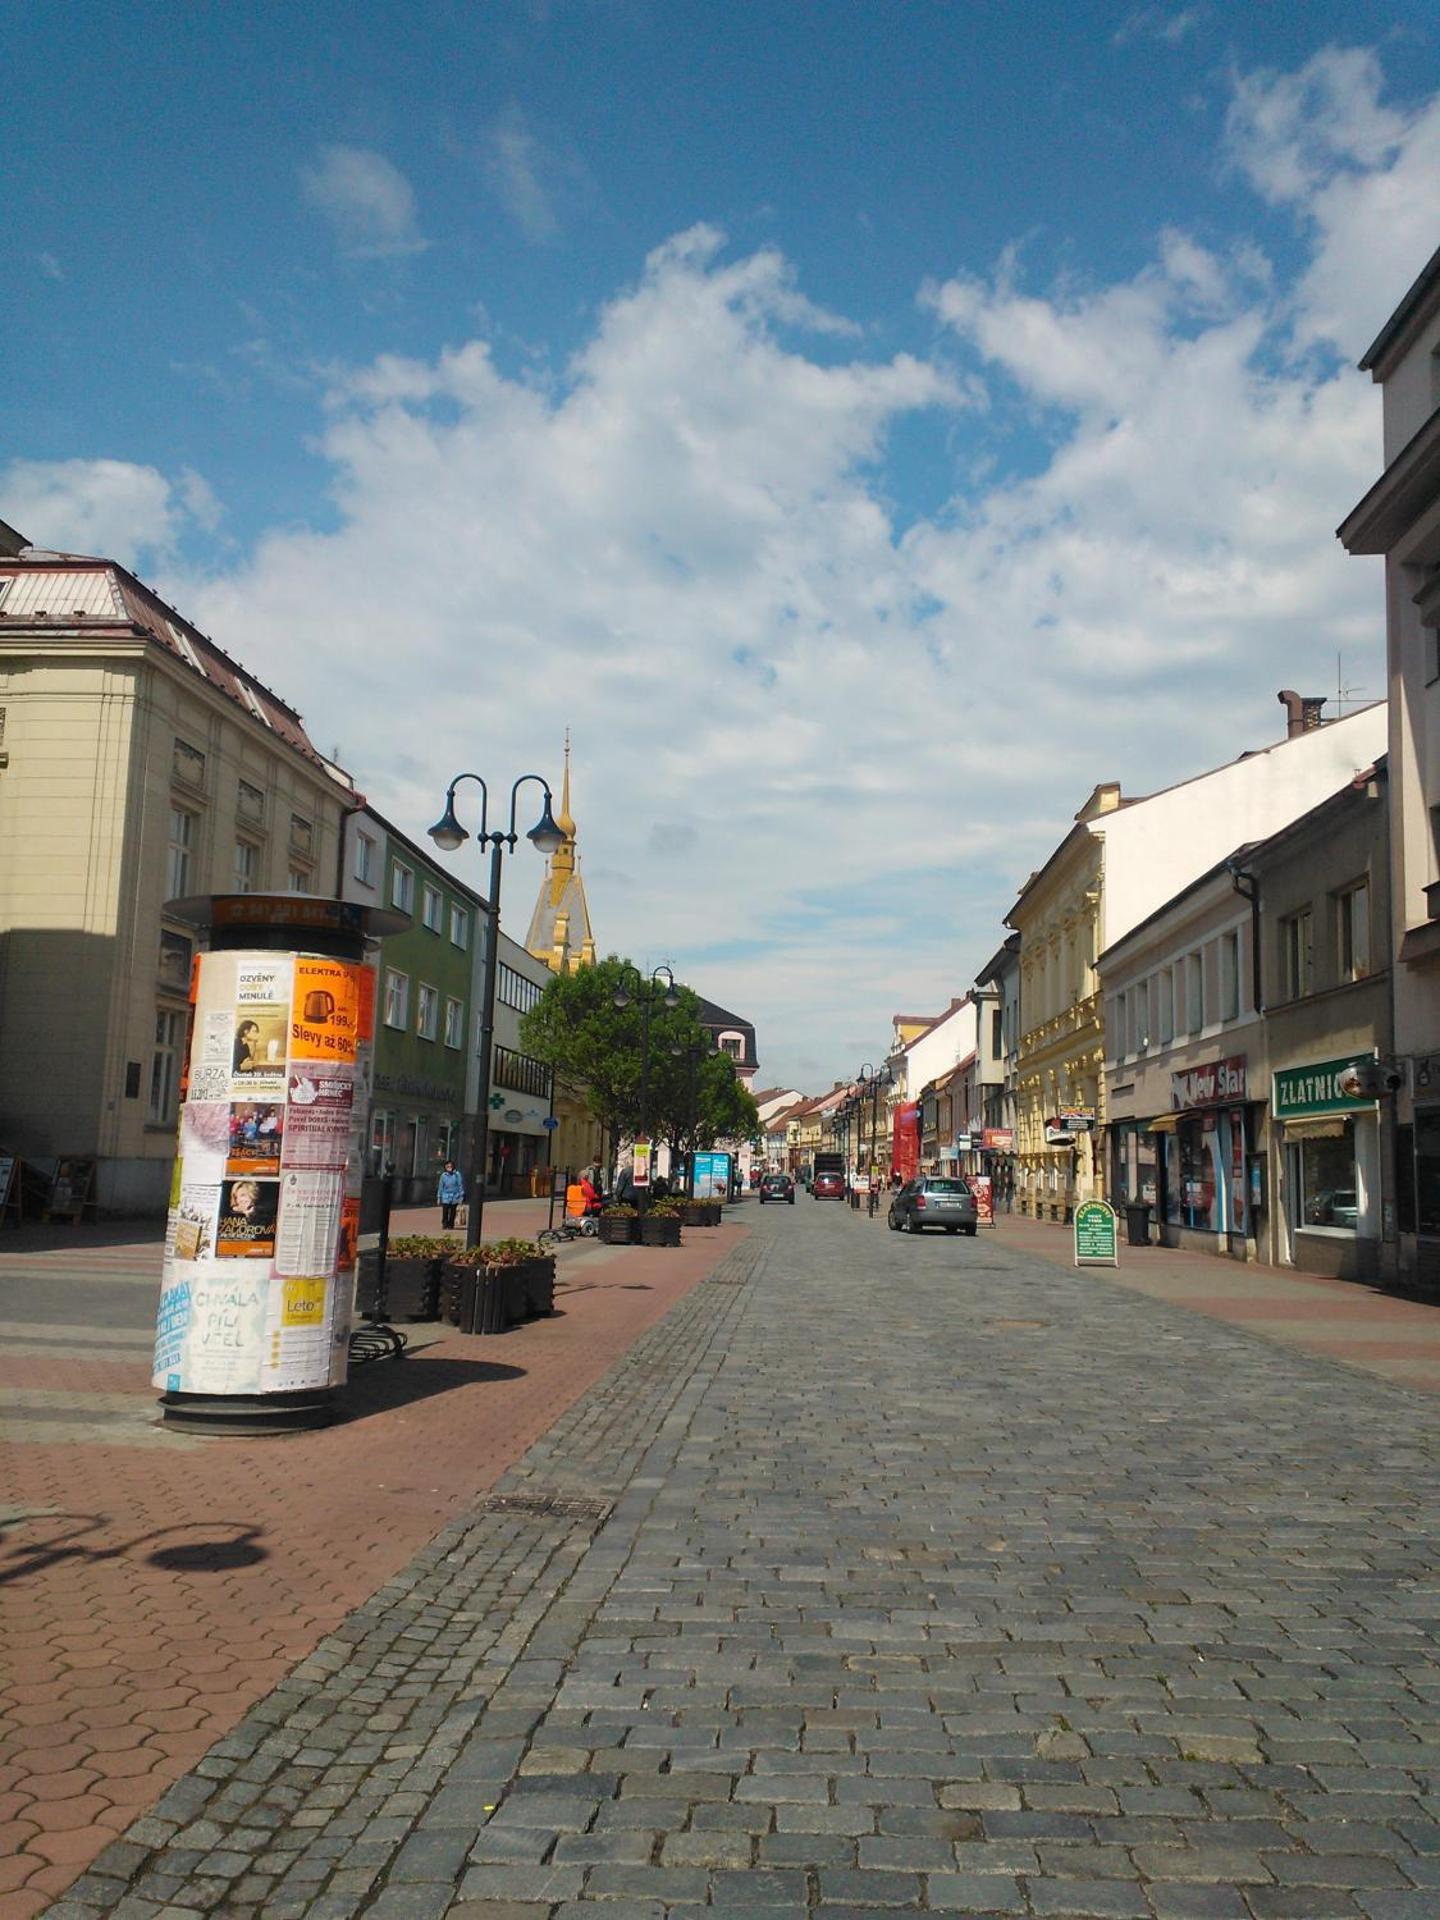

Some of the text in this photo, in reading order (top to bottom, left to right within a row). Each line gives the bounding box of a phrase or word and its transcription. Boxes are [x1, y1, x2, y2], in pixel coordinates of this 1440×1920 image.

[299, 966, 341, 977] ELEKTRA
[240, 991, 273, 1000] MINULÉ
[292, 1023, 322, 1048] Slevy
[194, 1068, 226, 1081] BURZA
[1218, 1065, 1244, 1096] Star
[1280, 1071, 1343, 1106] ZLATNIC
